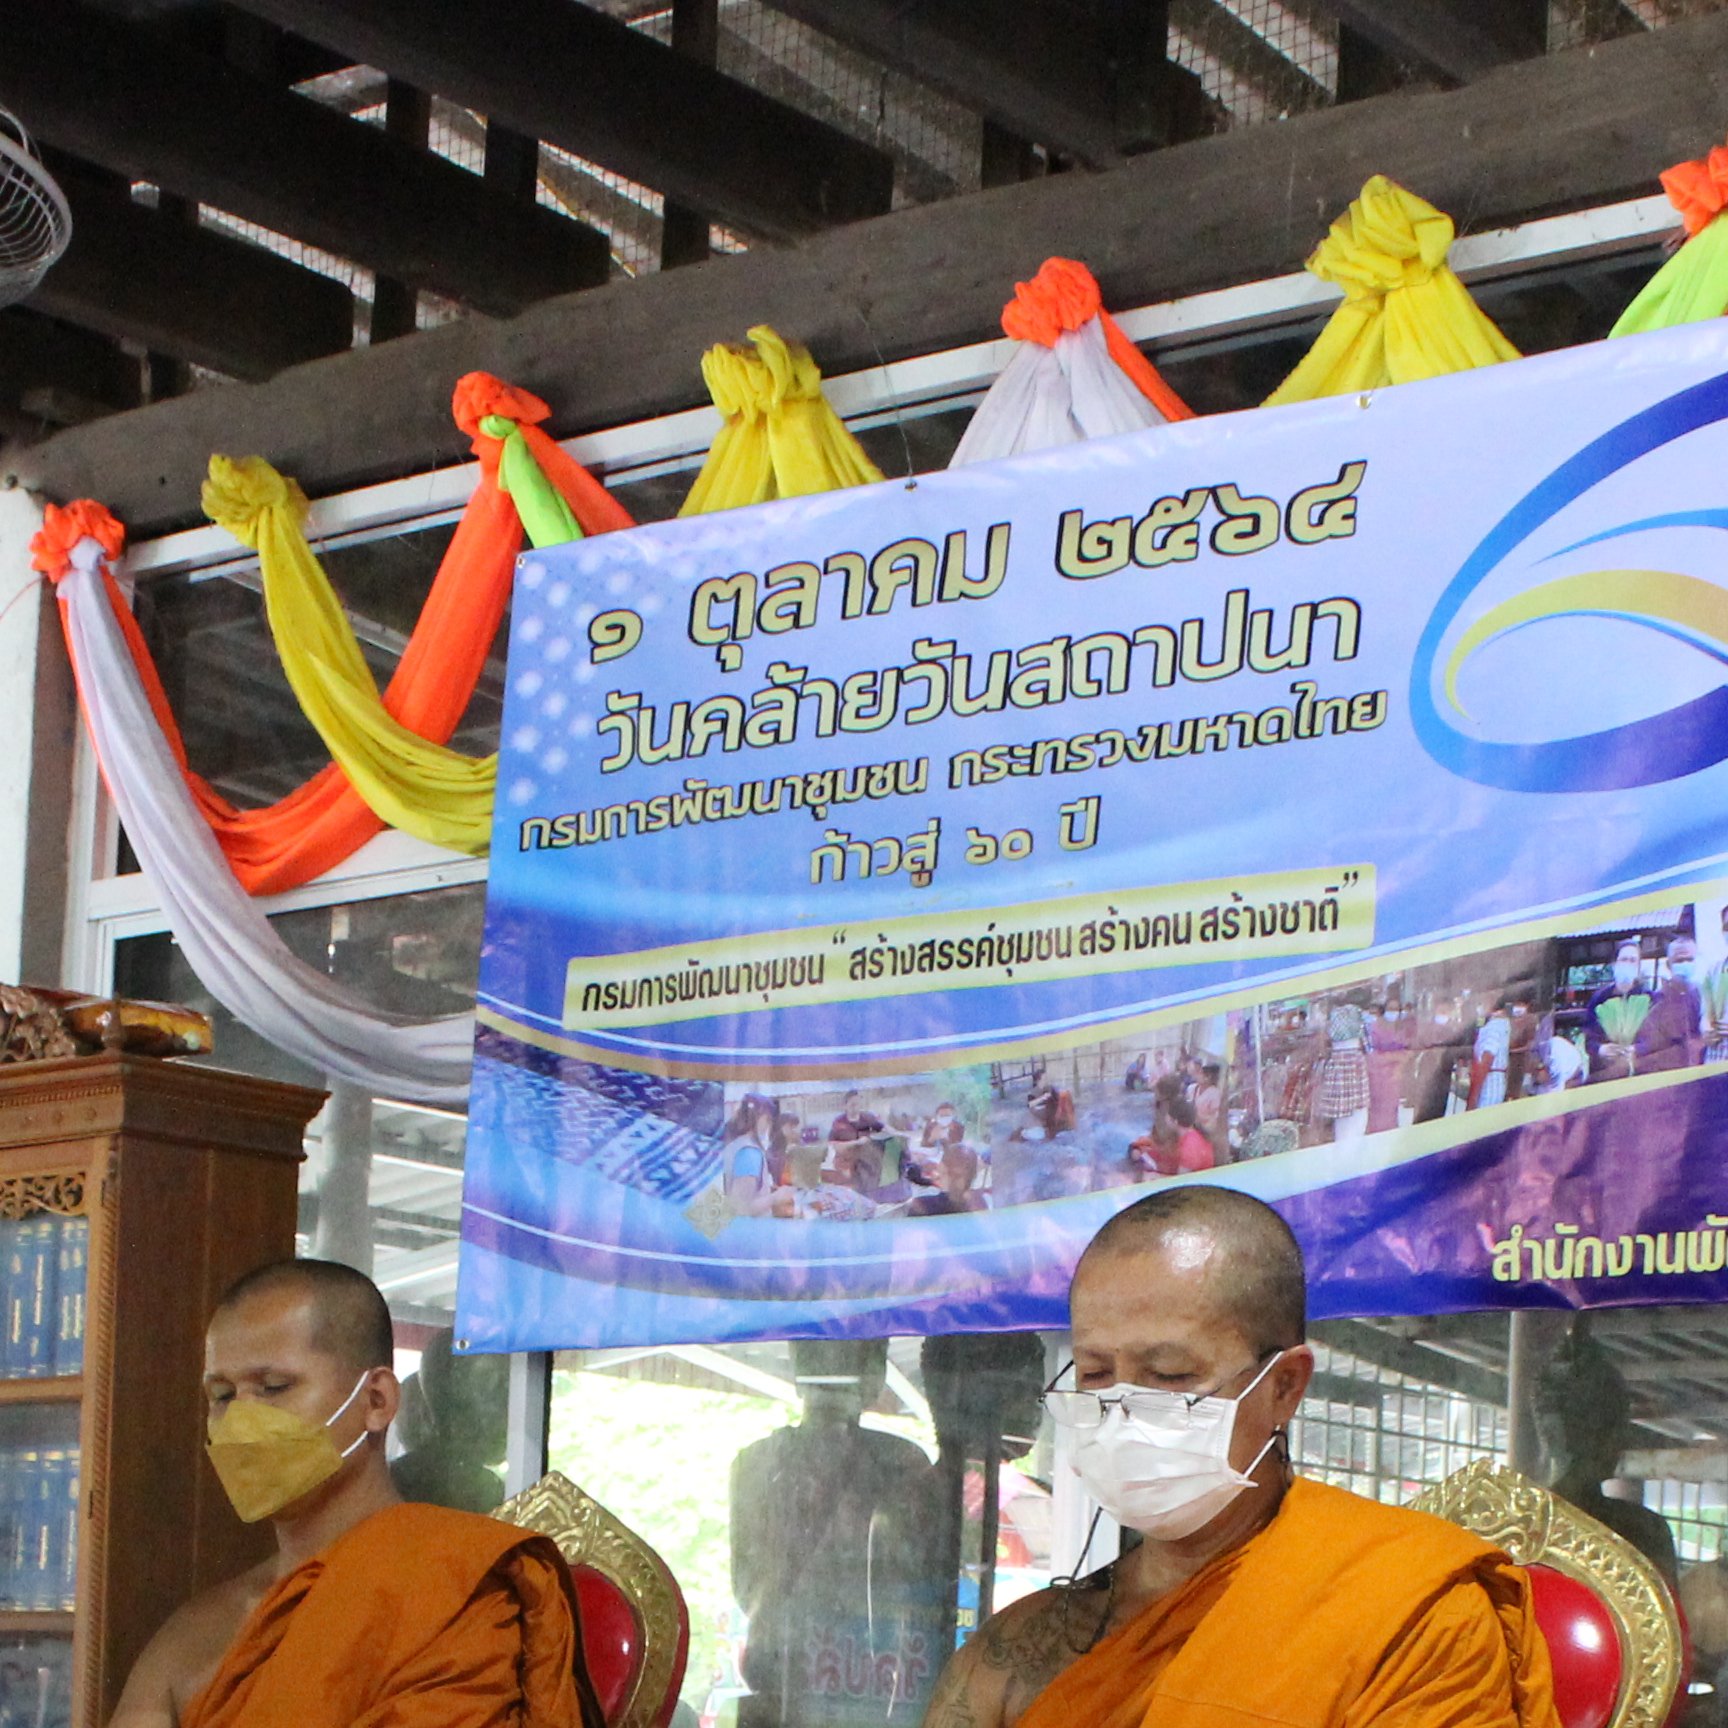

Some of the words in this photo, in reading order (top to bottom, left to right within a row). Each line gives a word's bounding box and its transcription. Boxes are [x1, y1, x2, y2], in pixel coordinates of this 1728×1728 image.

[588, 608, 643, 664] ๑
[688, 522, 1011, 672] ตุลาคม
[1055, 459, 1368, 579] ๒๕๖๔
[597, 588, 1363, 773] วันคล้ายวันสถาปนา
[519, 754, 929, 852] กรมการพัฒนาชุมชน
[948, 681, 1388, 799] กระทรวงมหาดไทย
[810, 817, 941, 887] ก้าวสู่
[966, 827, 1032, 867] ๖๐
[1057, 796, 1101, 850] ปี
[581, 953, 825, 1012] กรมการพัฒนาชุมชน
[1078, 906, 1192, 957] สร้างคน
